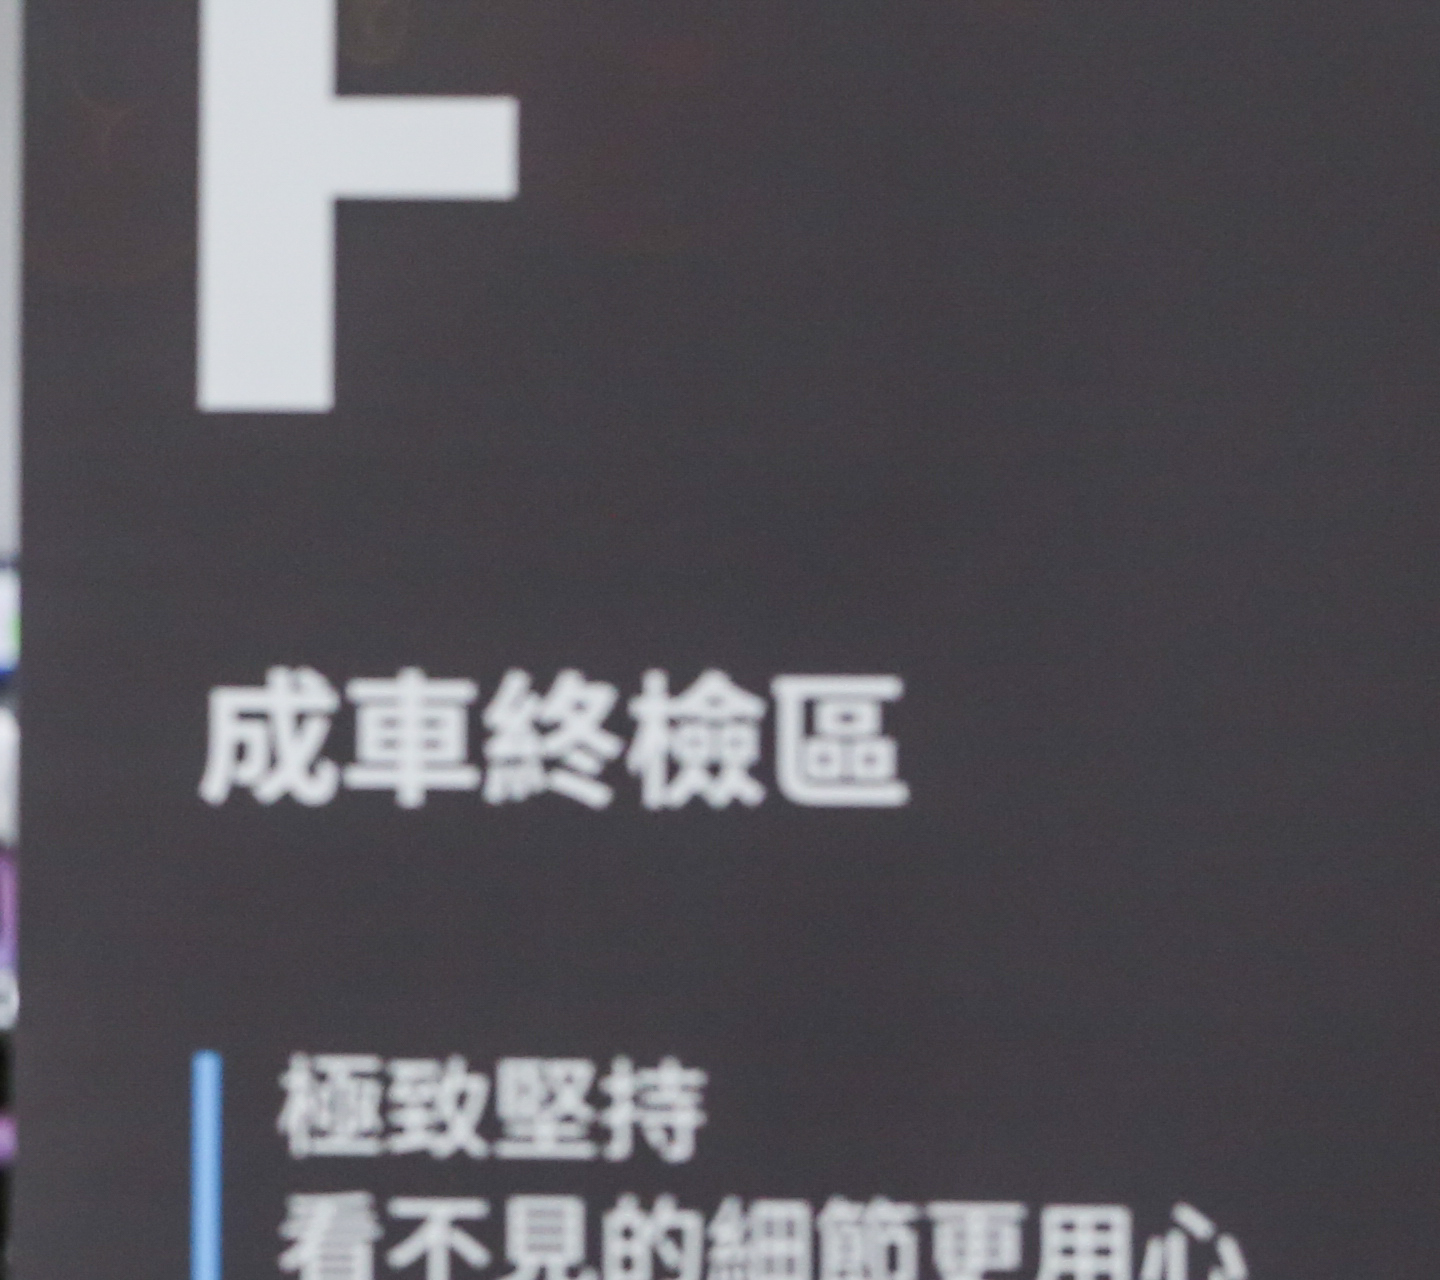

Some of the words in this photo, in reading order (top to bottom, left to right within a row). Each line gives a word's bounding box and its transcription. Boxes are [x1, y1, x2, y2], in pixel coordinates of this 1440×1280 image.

[198, 665, 911, 811] 成車終檢區
[277, 1051, 708, 1164] 極致堅持
